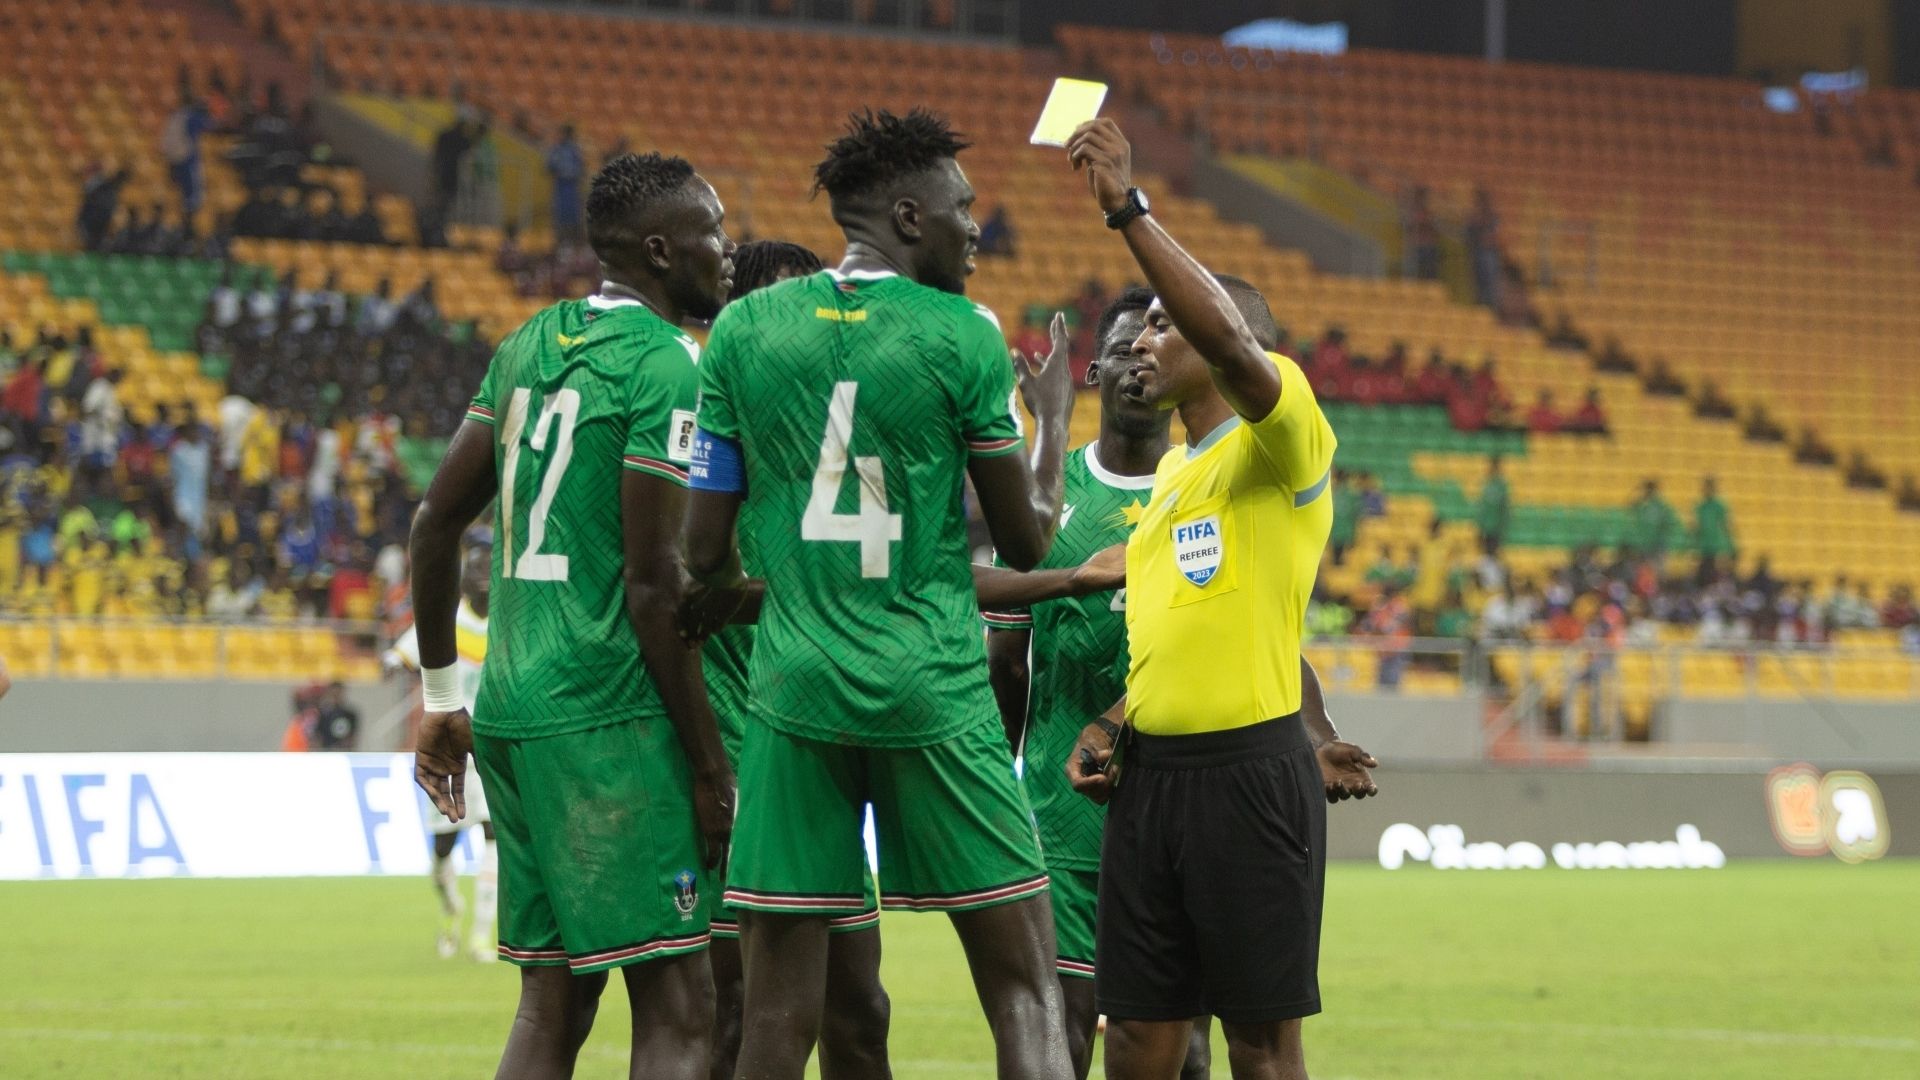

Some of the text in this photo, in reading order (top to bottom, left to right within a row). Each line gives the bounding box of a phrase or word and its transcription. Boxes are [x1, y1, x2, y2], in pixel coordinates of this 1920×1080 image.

[501, 387, 581, 582] 12
[802, 381, 902, 578] 4
[1177, 521, 1216, 544] FIFA
[1180, 546, 1219, 562] REFEREE
[1192, 569, 1211, 580] 2023
[0, 773, 188, 867] IFA
